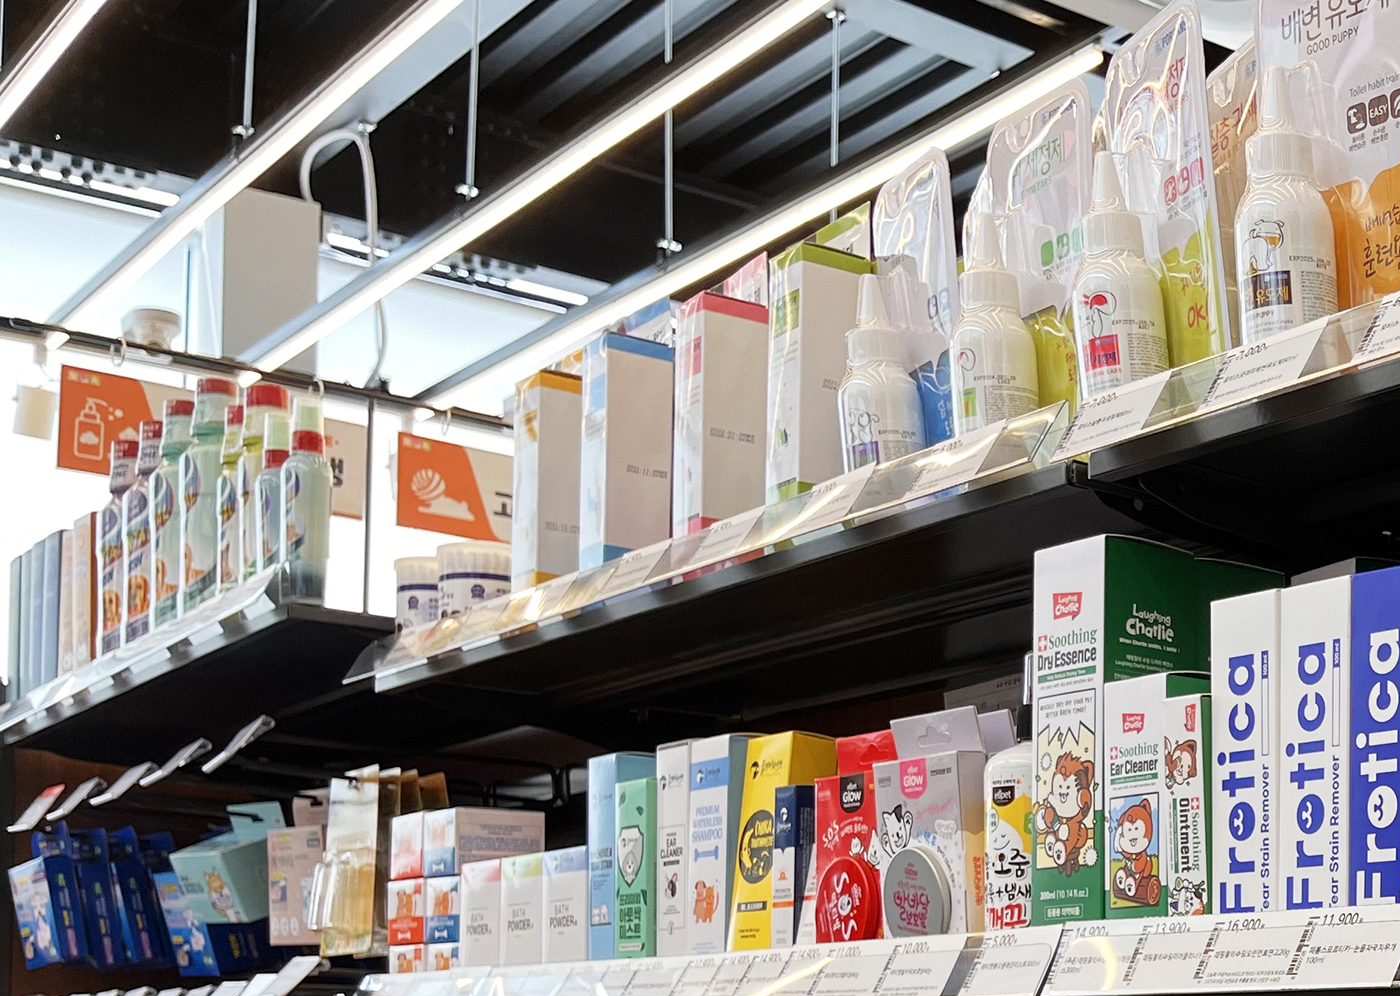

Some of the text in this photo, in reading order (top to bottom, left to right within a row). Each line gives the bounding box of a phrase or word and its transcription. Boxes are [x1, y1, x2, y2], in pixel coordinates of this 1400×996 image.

[1306, 25, 1360, 56] GOOD PUPPY
[1349, 84, 1367, 99] Toilet
[1367, 79, 1386, 94] habit
[1369, 102, 1389, 118] EASY
[1055, 601, 1080, 616] Charlie
[1133, 603, 1173, 626] Laughing
[1049, 628, 1098, 651] Soothing
[1126, 618, 1175, 643] Charlie
[1037, 646, 1097, 672] Dry Essence
[1119, 742, 1160, 759] Soothing
[1110, 758, 1160, 777] Ear Cleaner
[1286, 641, 1327, 911] Frotica
[1356, 628, 1400, 907] Frotica
[1218, 653, 1256, 914] Frotica
[1260, 763, 1271, 879] Stain Remover
[666, 838, 677, 848] EAR
[692, 828, 723, 843] SHAMPOO
[1178, 797, 1194, 873] Ointment
[1190, 811, 1202, 873] Soothing
[660, 846, 684, 859] CLEANER
[993, 848, 1031, 878] 오줌
[1004, 883, 1032, 902] 냄새
